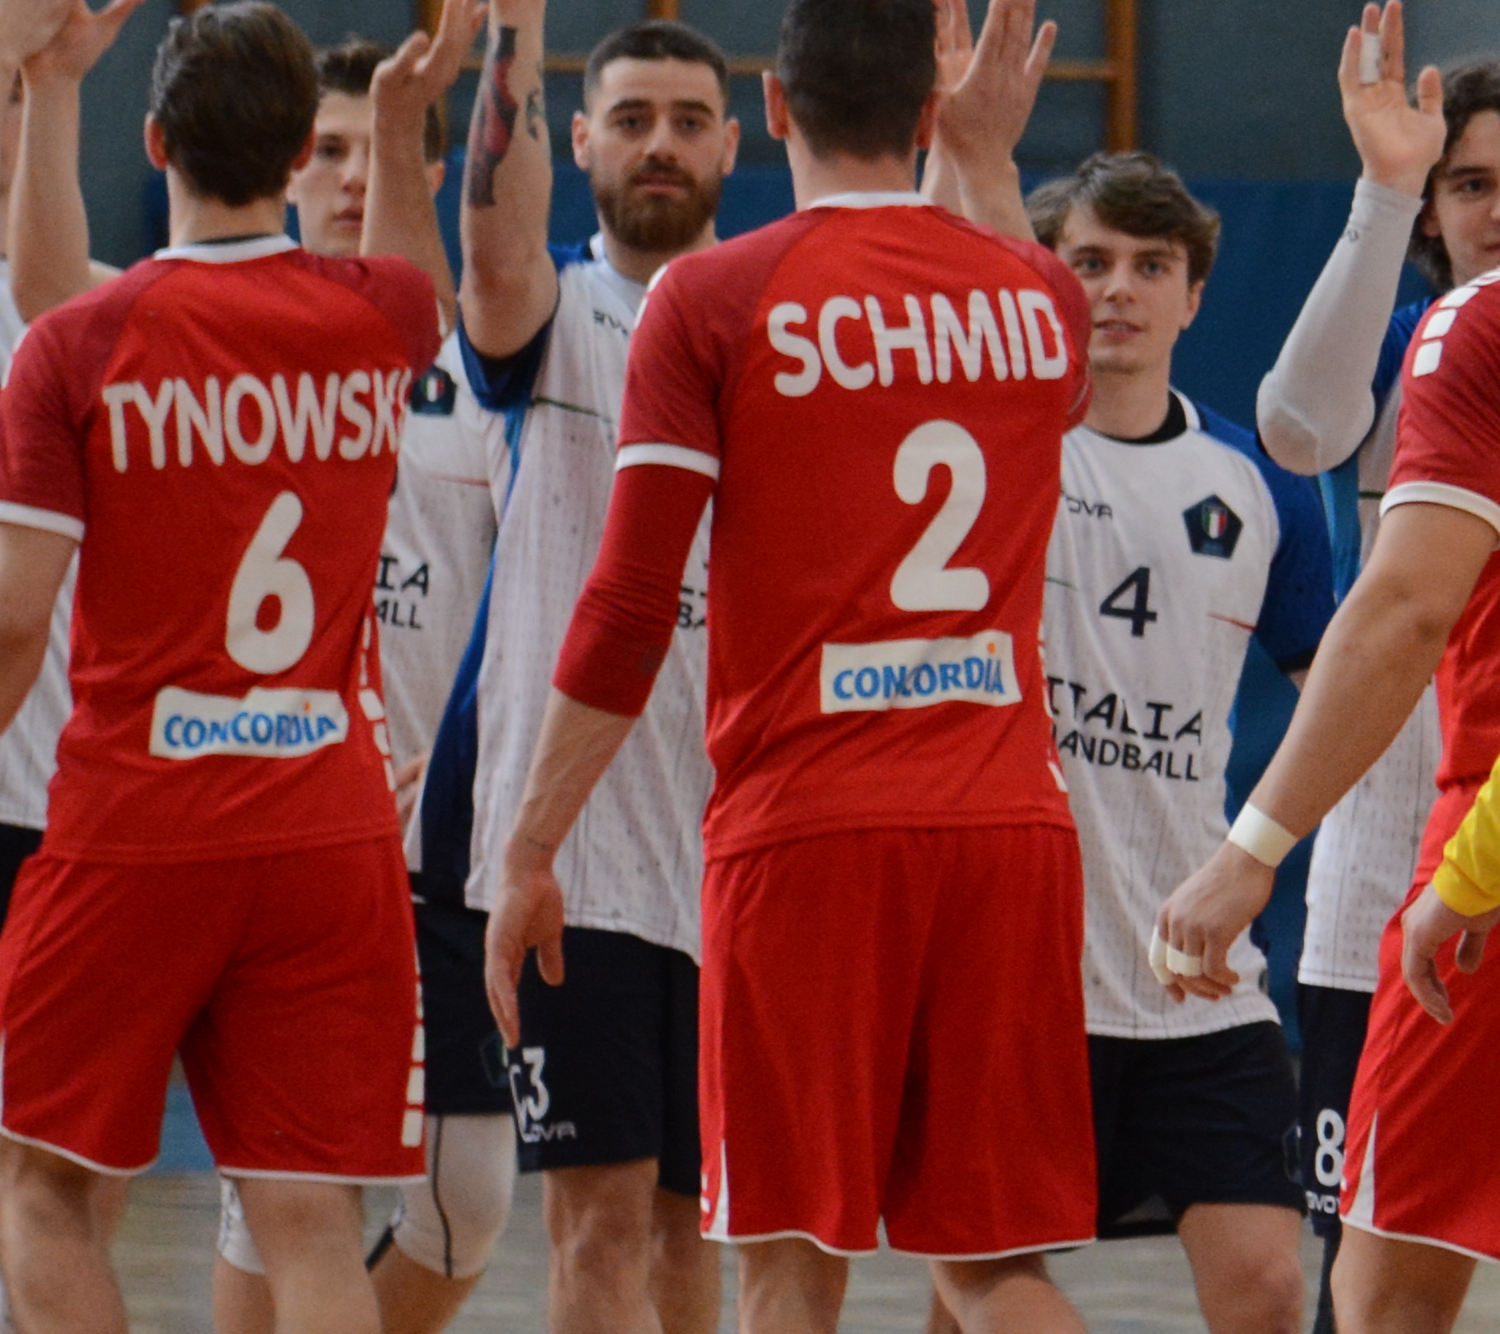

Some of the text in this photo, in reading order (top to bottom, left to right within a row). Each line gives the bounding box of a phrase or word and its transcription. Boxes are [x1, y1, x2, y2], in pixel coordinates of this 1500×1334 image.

[767, 288, 1068, 397] SCHMID
[102, 368, 412, 473] TYNOWSK
[890, 419, 990, 611] 2
[225, 490, 314, 674] 6
[1100, 566, 1157, 637] 4
[1052, 725, 1199, 781] ANDBALL
[1315, 1108, 1345, 1187] 8
